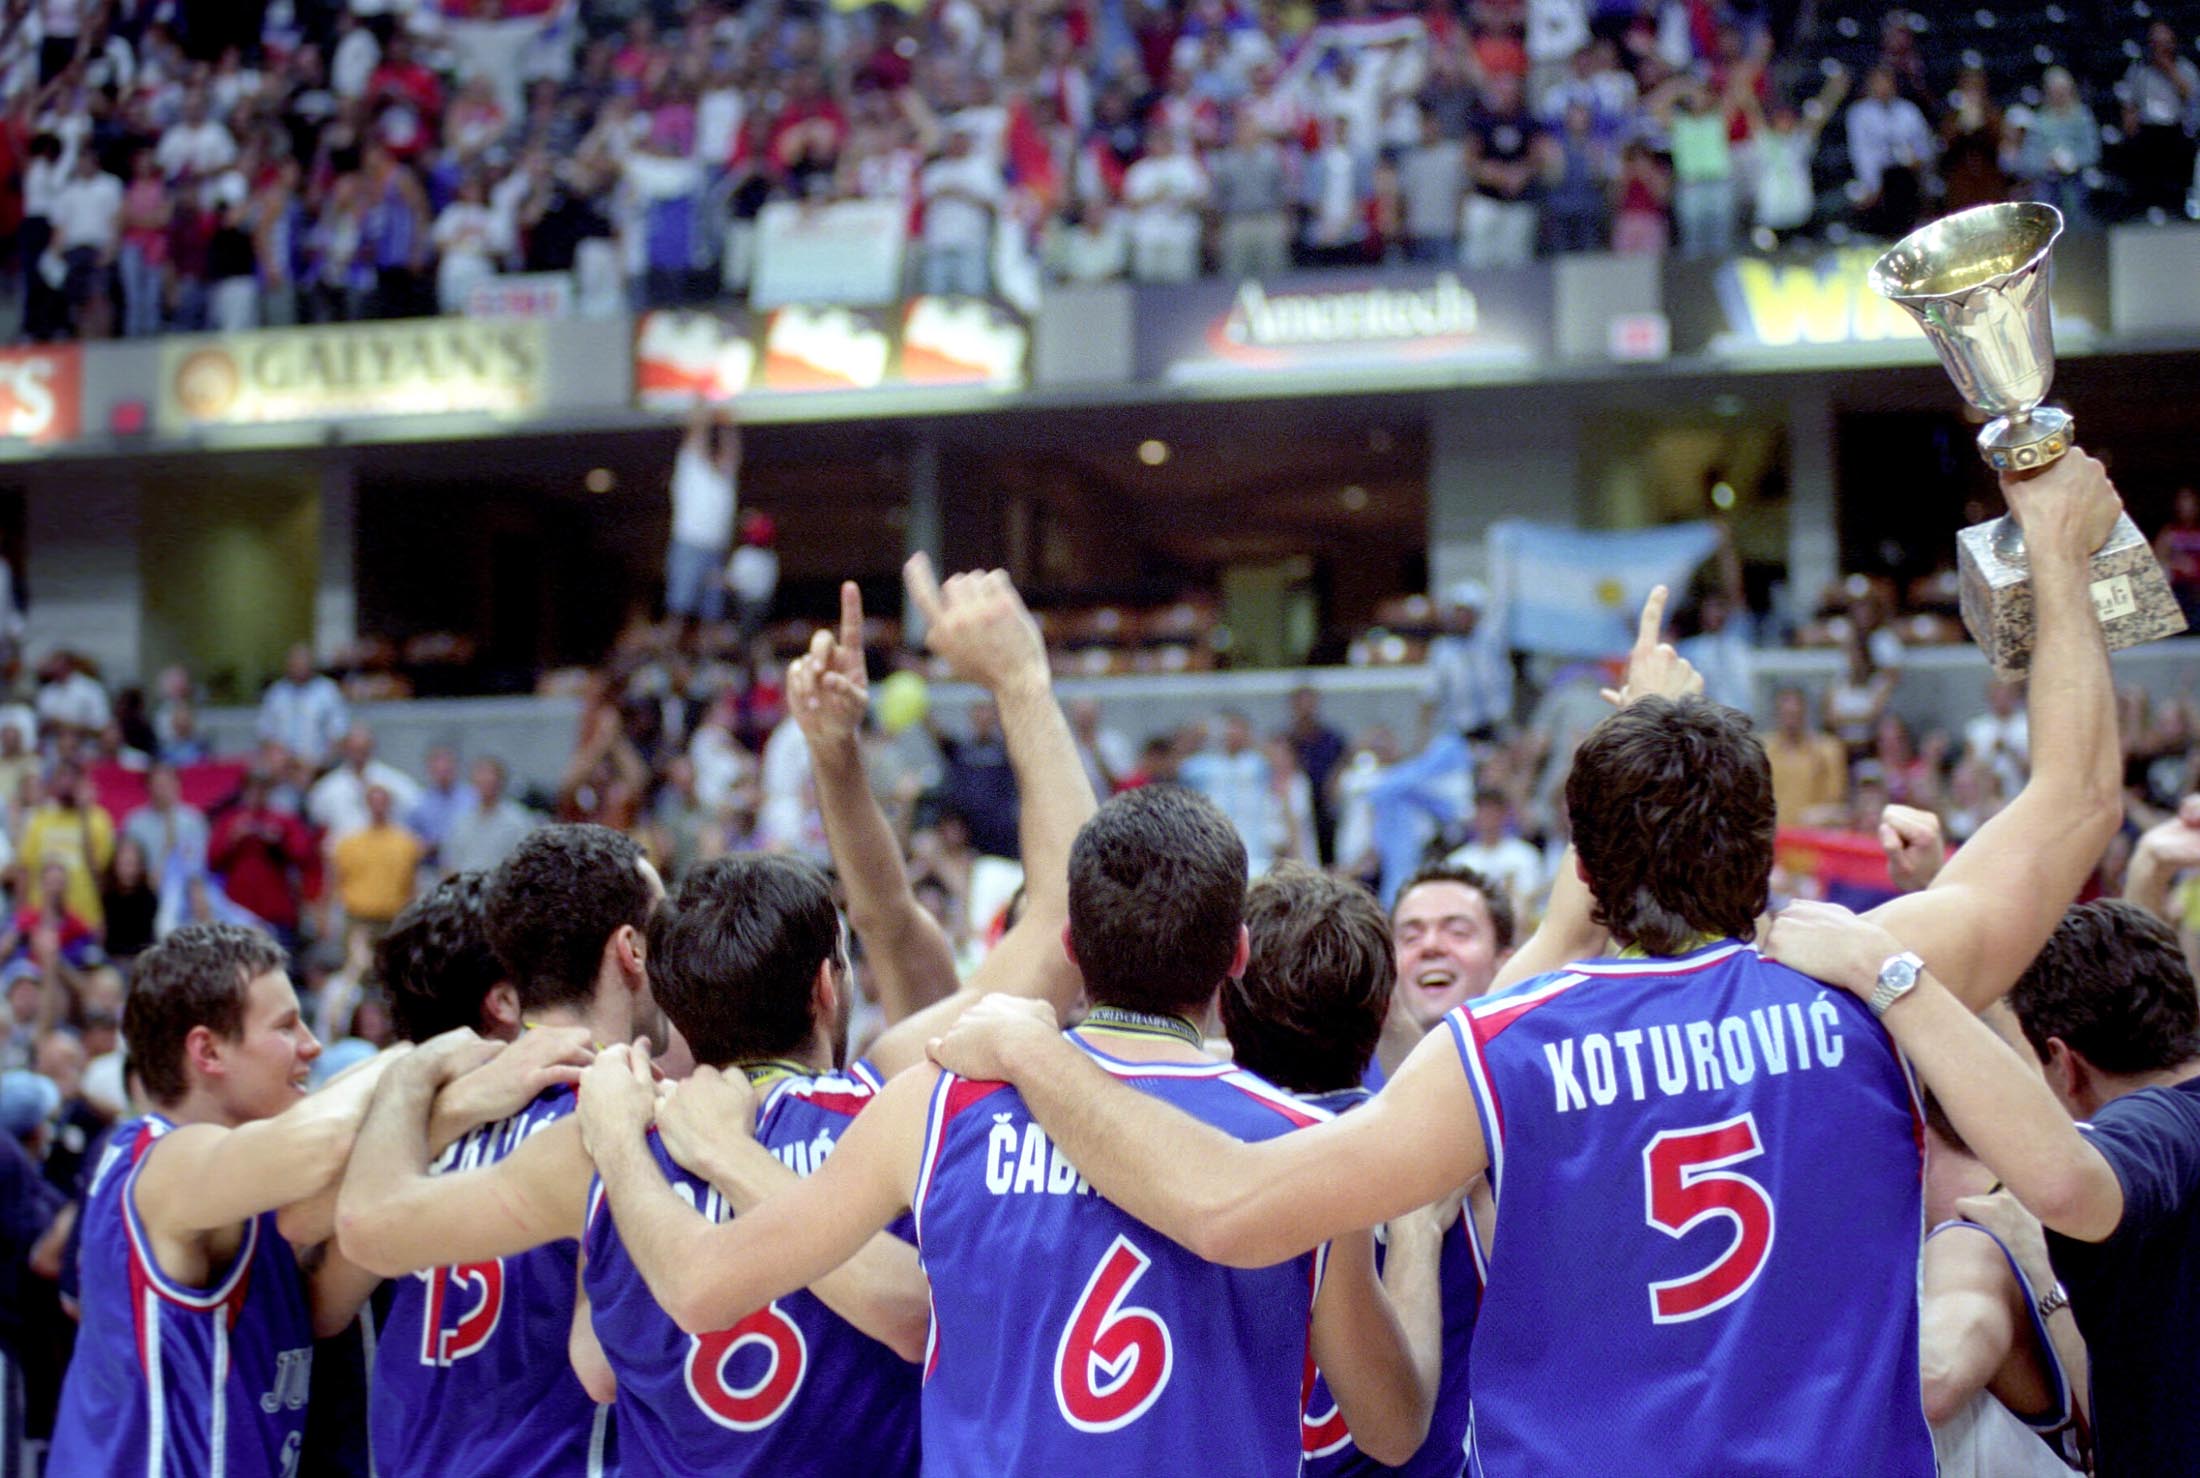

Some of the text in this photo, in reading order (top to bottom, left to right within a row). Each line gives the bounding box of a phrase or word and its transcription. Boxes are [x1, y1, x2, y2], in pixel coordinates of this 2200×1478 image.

[1543, 991, 1844, 1113] KOTUROVIĆ
[1642, 1111, 1775, 1325] 5
[1053, 1233, 1174, 1434] 6
